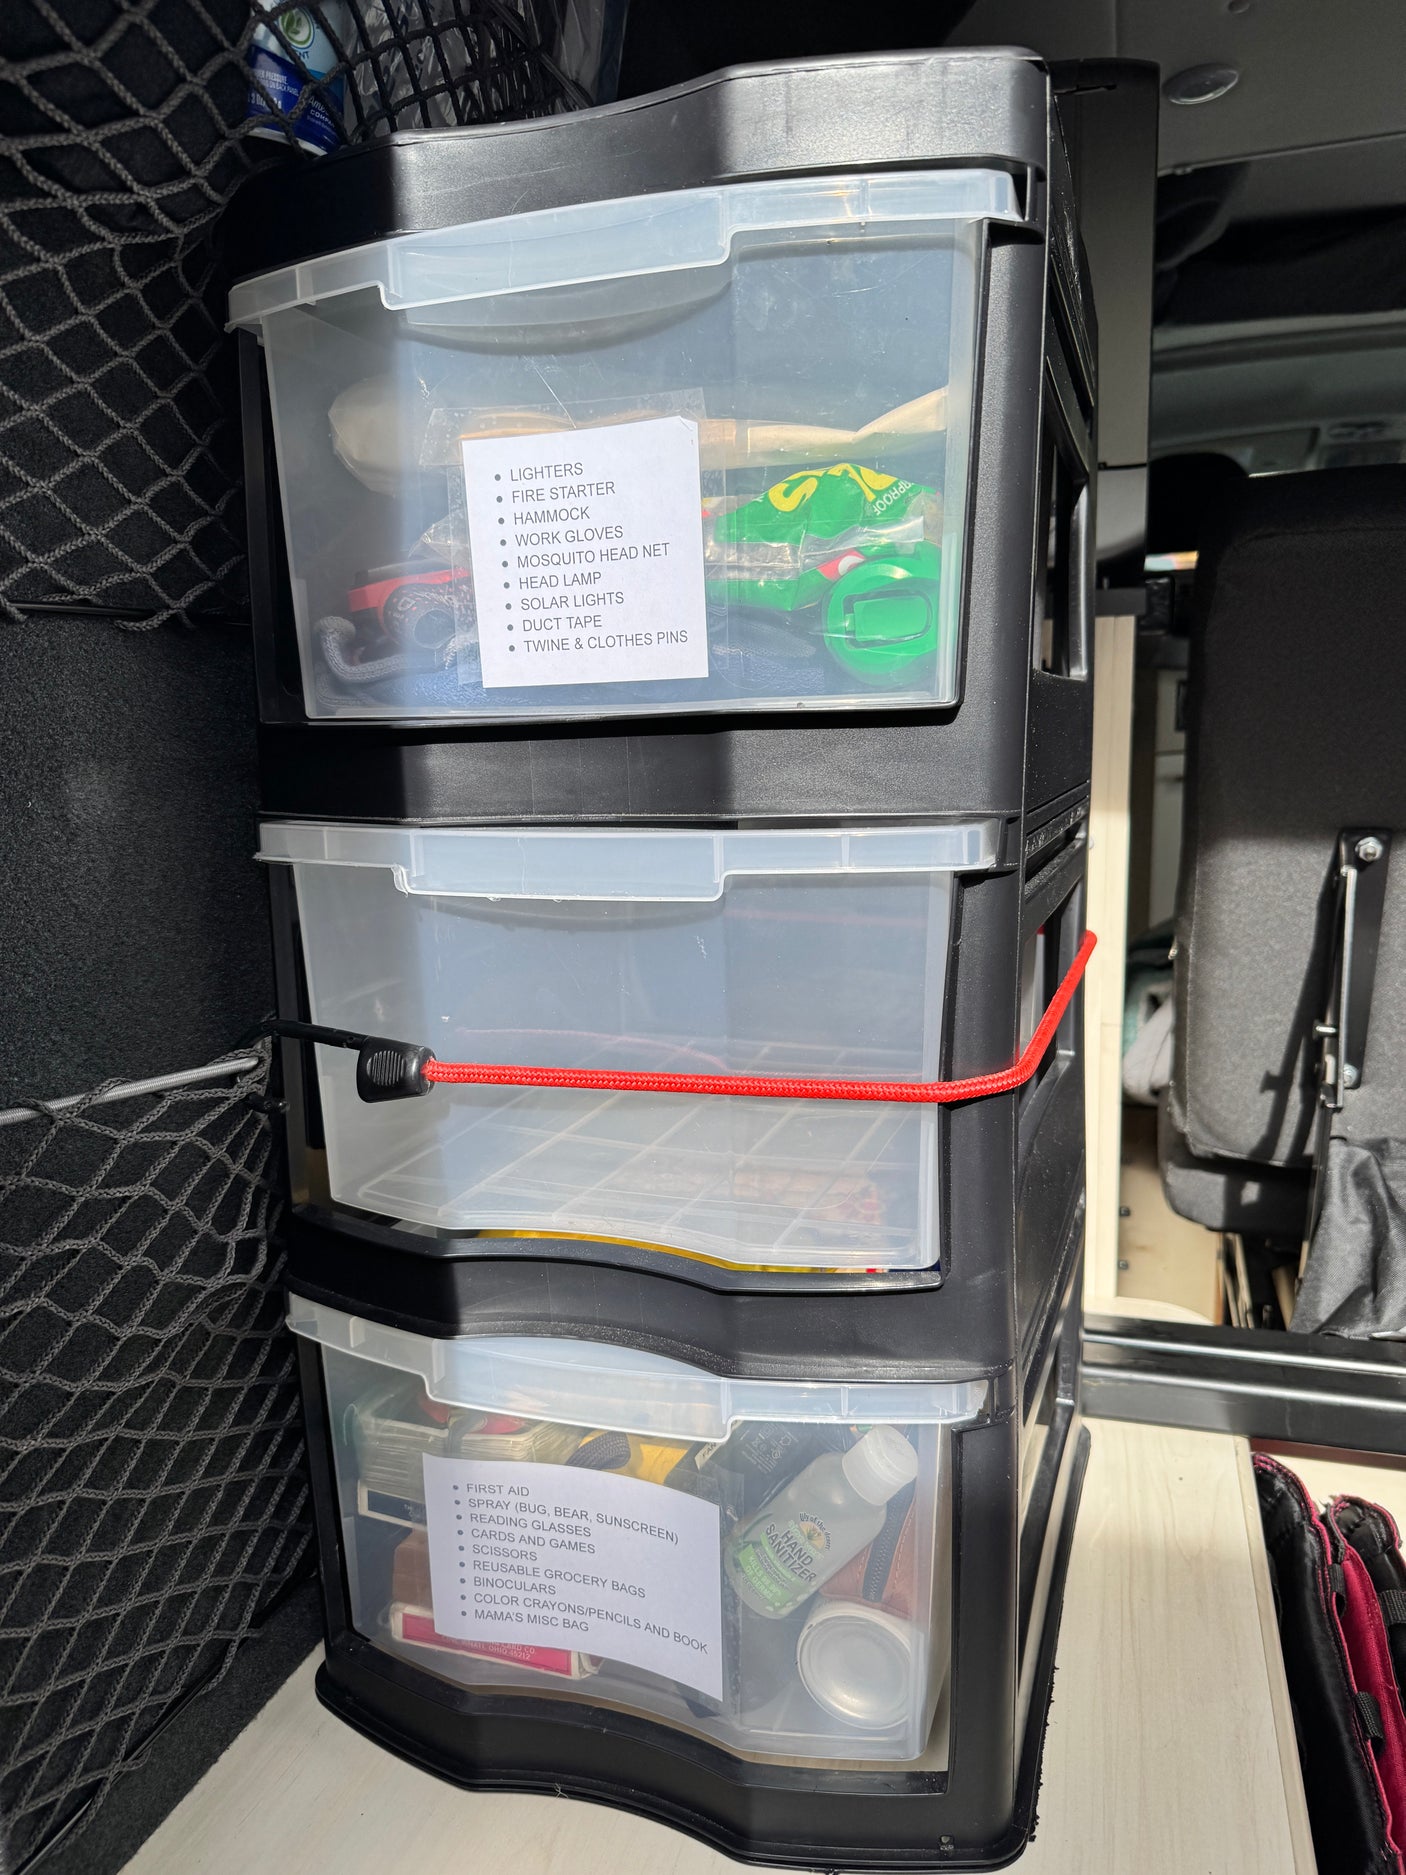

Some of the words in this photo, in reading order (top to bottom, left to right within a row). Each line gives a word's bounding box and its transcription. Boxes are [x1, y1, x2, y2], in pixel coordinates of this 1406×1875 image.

[510, 462, 583, 482] LIGHTERS
[512, 489, 545, 503] FIRE
[550, 481, 615, 500] STARTER
[871, 480, 914, 517] RPROOF
[514, 507, 590, 525] HAMMOCK
[515, 530, 561, 546] WORK
[565, 526, 623, 543] GLOVES
[517, 550, 595, 568] MOSQUITO
[600, 546, 638, 562] HEAD
[642, 543, 670, 557] NET
[519, 575, 559, 589] HEAD
[563, 572, 602, 587] LAMP
[521, 596, 569, 610] SOLAR
[573, 592, 624, 607] LIGHTS
[523, 618, 562, 632] DUCT
[567, 615, 602, 629] TAPE
[524, 638, 569, 652] TWINE
[575, 638, 583, 650] &
[587, 633, 652, 649] CLOTHES
[657, 630, 688, 644] PINS
[466, 1483, 503, 1495] FIRST
[508, 1485, 530, 1496] AID
[469, 1498, 510, 1511] SPRAY
[515, 1502, 550, 1517] (BUG,
[554, 1507, 592, 1523] BEAR,
[596, 1513, 679, 1545] SUNSCREEN)
[470, 1513, 528, 1529] READING
[531, 1520, 591, 1537] GLASSES
[471, 1528, 515, 1543] CARDS
[518, 1534, 546, 1547] AND
[549, 1538, 595, 1554] GAMES
[780, 1531, 814, 1567] HAND
[472, 1544, 538, 1561] SCISSORS
[765, 1523, 817, 1582] SANITIZER
[473, 1560, 540, 1578] REUSABLE
[544, 1568, 608, 1588] GROCERY
[611, 1582, 645, 1598] BAGS
[474, 1576, 556, 1595] BINOCULARS
[474, 1609, 524, 1622] MAMA'S
[527, 1613, 560, 1626] MISC
[562, 1617, 589, 1632] BAG
[474, 1592, 520, 1607] COLOR
[523, 1597, 642, 1630] CRAYONS/PENCILS
[644, 1622, 670, 1638] AND
[674, 1632, 709, 1654] BOOK
